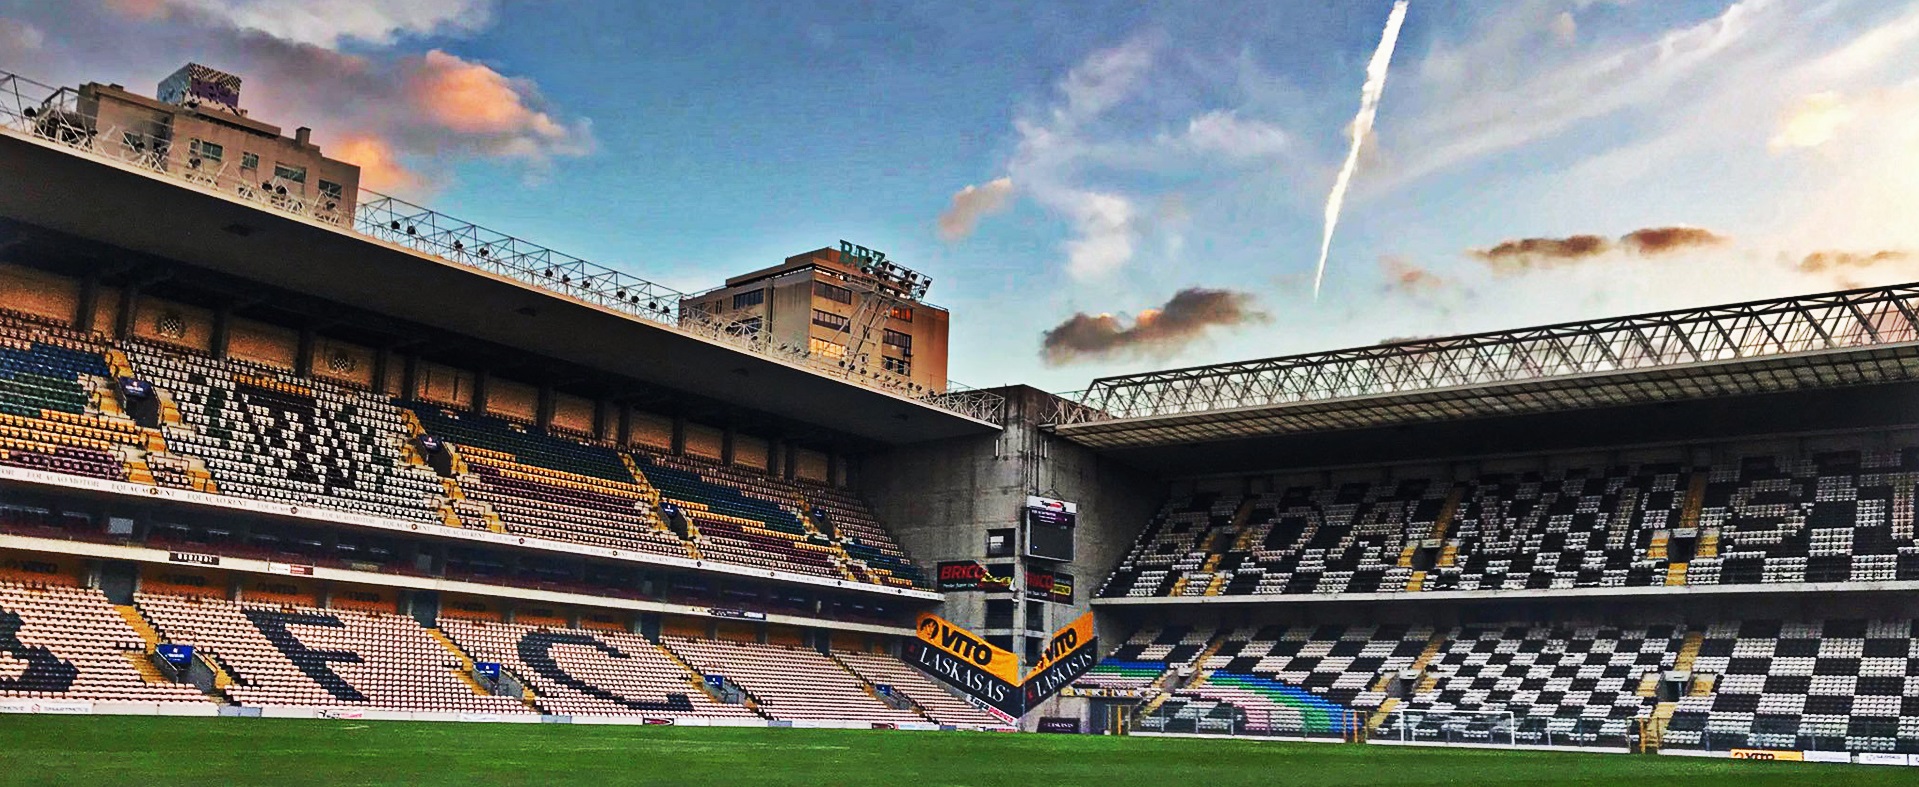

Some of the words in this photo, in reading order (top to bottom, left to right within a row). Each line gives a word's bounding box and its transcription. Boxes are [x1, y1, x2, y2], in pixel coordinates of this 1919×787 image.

[941, 624, 993, 666] VITO
[1045, 627, 1078, 663] VITO
[919, 646, 1007, 703] LASKASAS
